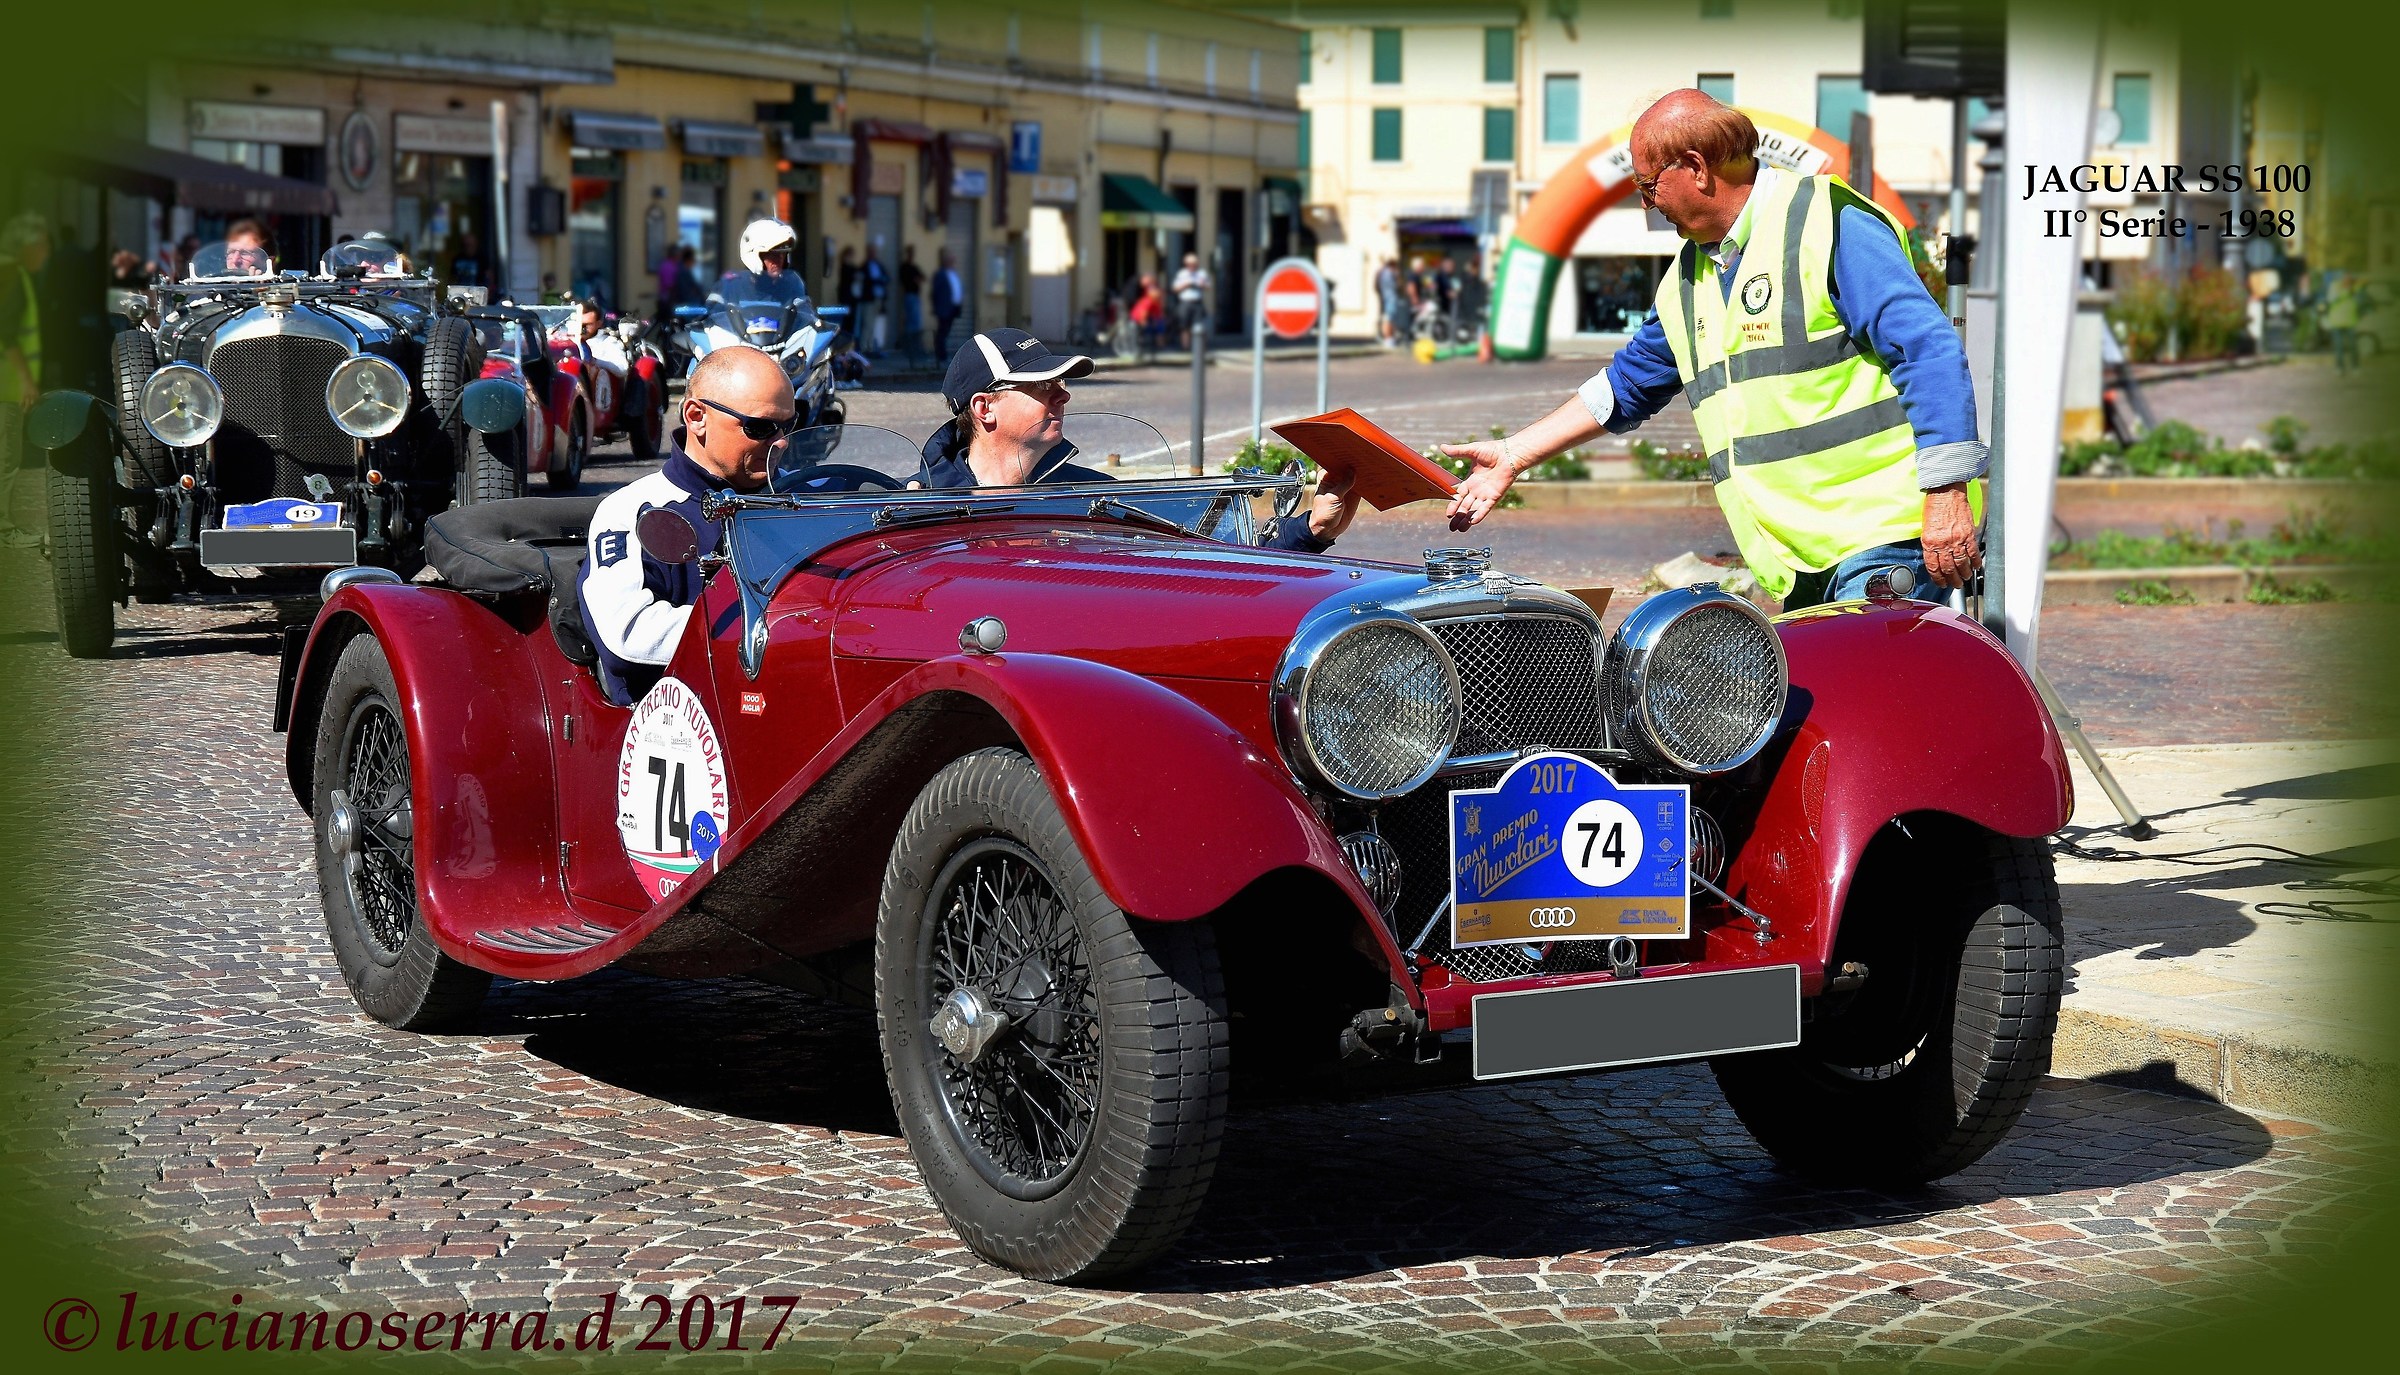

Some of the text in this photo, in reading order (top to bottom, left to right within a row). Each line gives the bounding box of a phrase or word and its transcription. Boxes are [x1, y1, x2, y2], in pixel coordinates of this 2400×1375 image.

[295, 509, 315, 518] 19
[744, 694, 759, 703] 1000
[662, 712, 673, 727] 2017
[620, 683, 725, 820] GRAN PREMIO NUVOLARI
[1529, 763, 1577, 794] 2017
[648, 755, 690, 859] 74
[696, 823, 716, 844] 2017
[1457, 808, 1538, 875] GRAN PREMIO
[1577, 822, 1625, 868] 74
[1473, 824, 1558, 896] Nuvolari
[1642, 916, 1678, 924] GENERALI
[1643, 909, 1667, 917] BANCA
